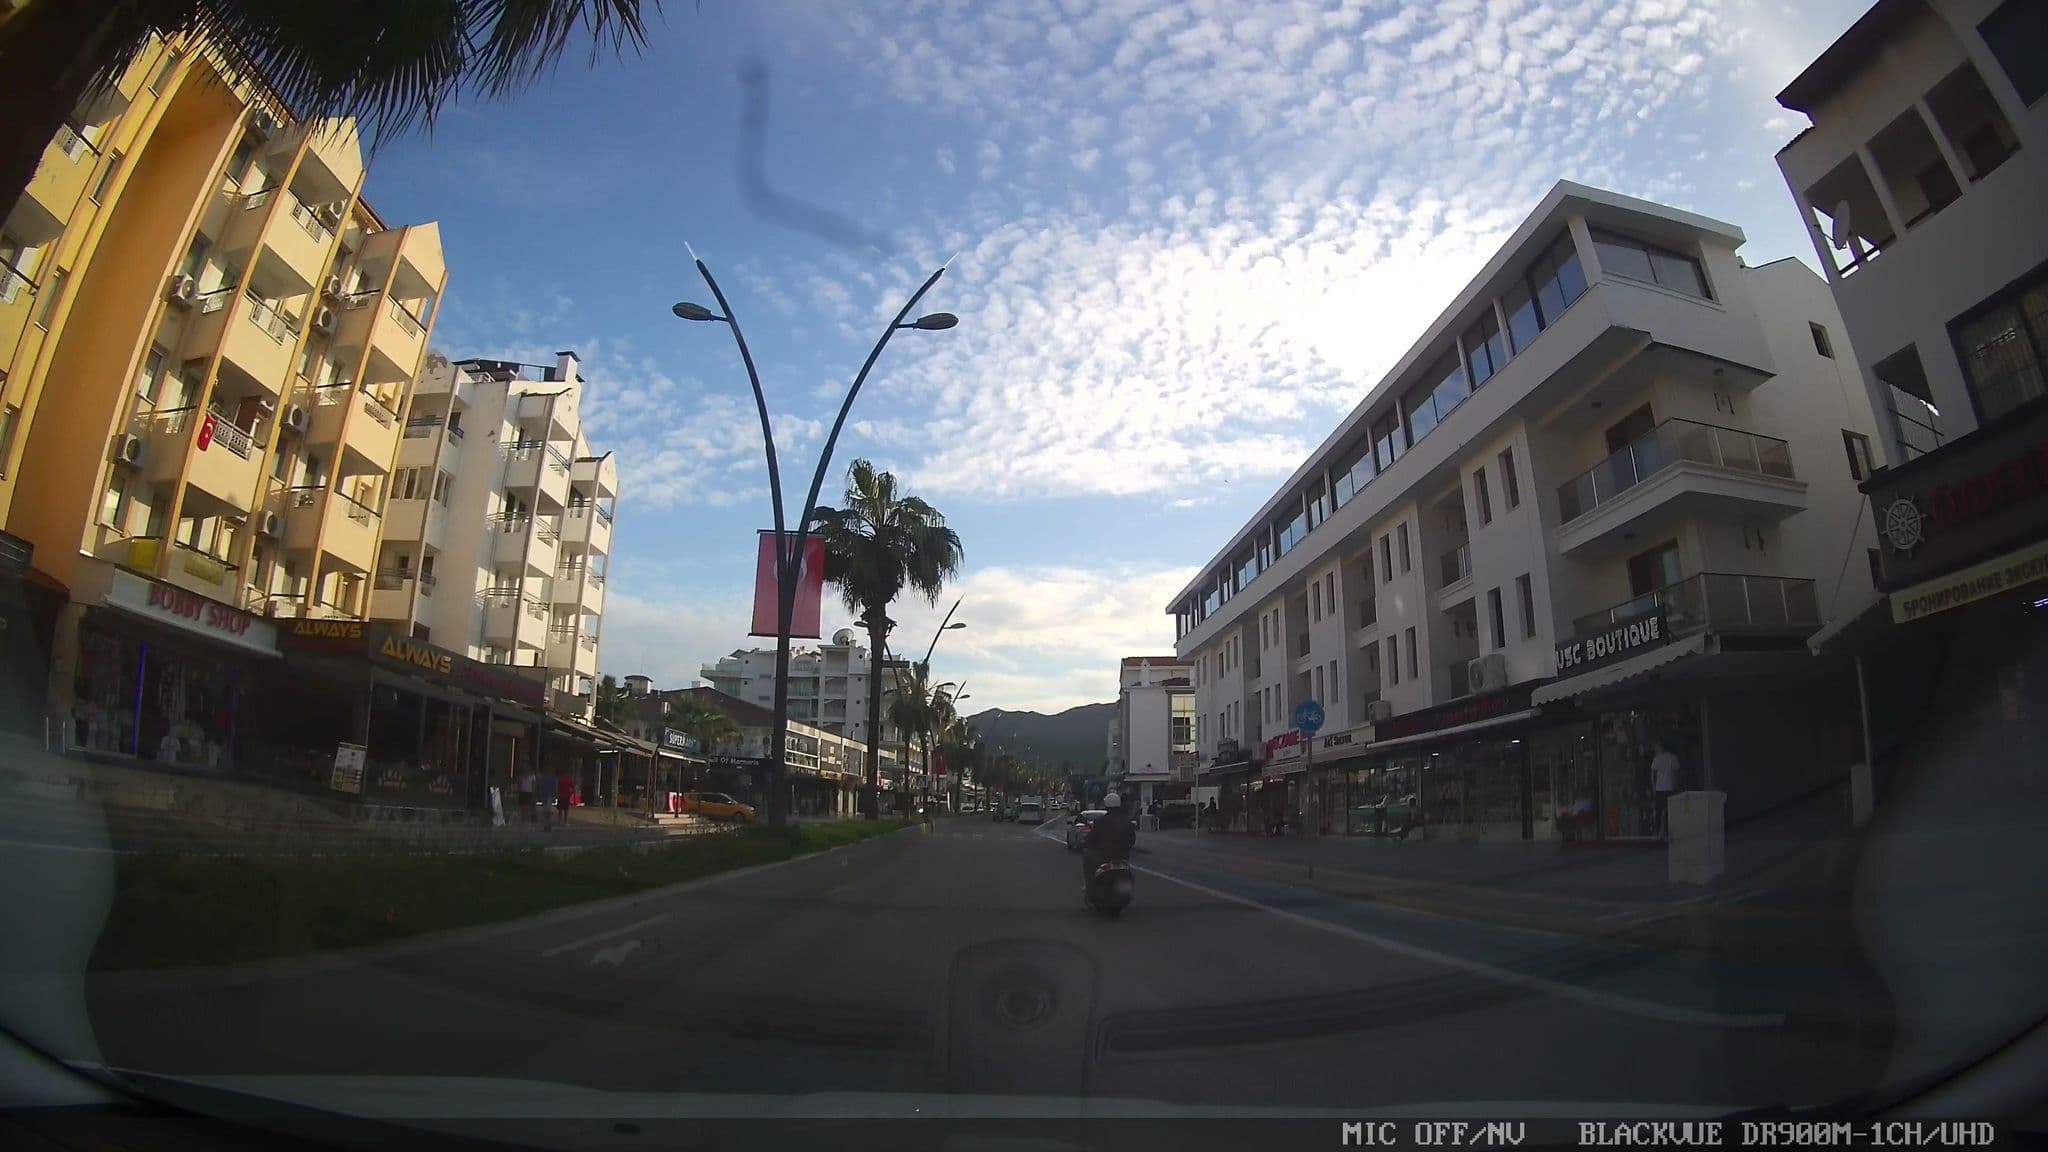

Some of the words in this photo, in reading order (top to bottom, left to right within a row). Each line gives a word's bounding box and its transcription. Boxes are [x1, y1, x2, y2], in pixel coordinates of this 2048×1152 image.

[207, 602, 251, 636] SHOP
[293, 621, 361, 639] ALWAYS
[381, 636, 452, 674] ALWAYS
[1555, 643, 1582, 669] USC
[1586, 616, 1660, 661] BOUTIQUE
